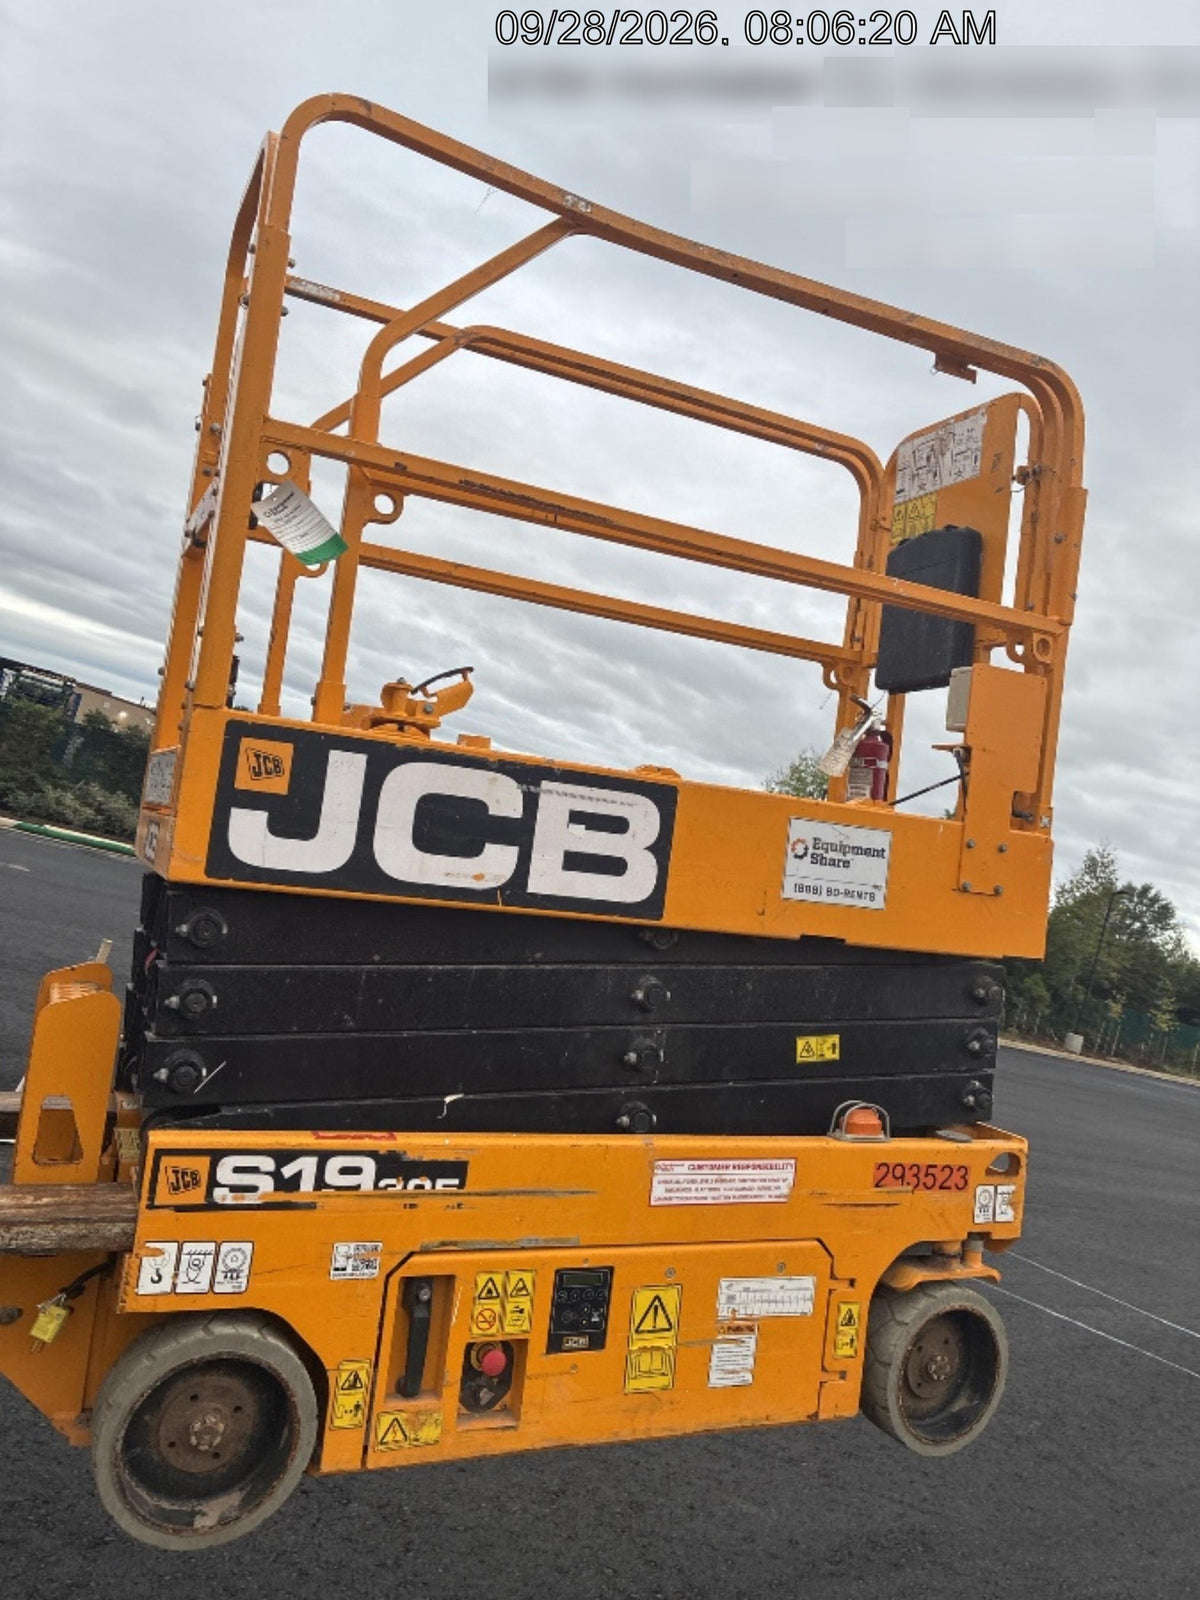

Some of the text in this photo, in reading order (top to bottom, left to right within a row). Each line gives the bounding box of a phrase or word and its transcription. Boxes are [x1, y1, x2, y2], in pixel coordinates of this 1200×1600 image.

[250, 750, 283, 779] JCB
[228, 749, 661, 904] JCB
[810, 852, 851, 869] Share
[811, 837, 886, 859] Equipment
[169, 1168, 201, 1193] JCB
[874, 1162, 969, 1191] 293523
